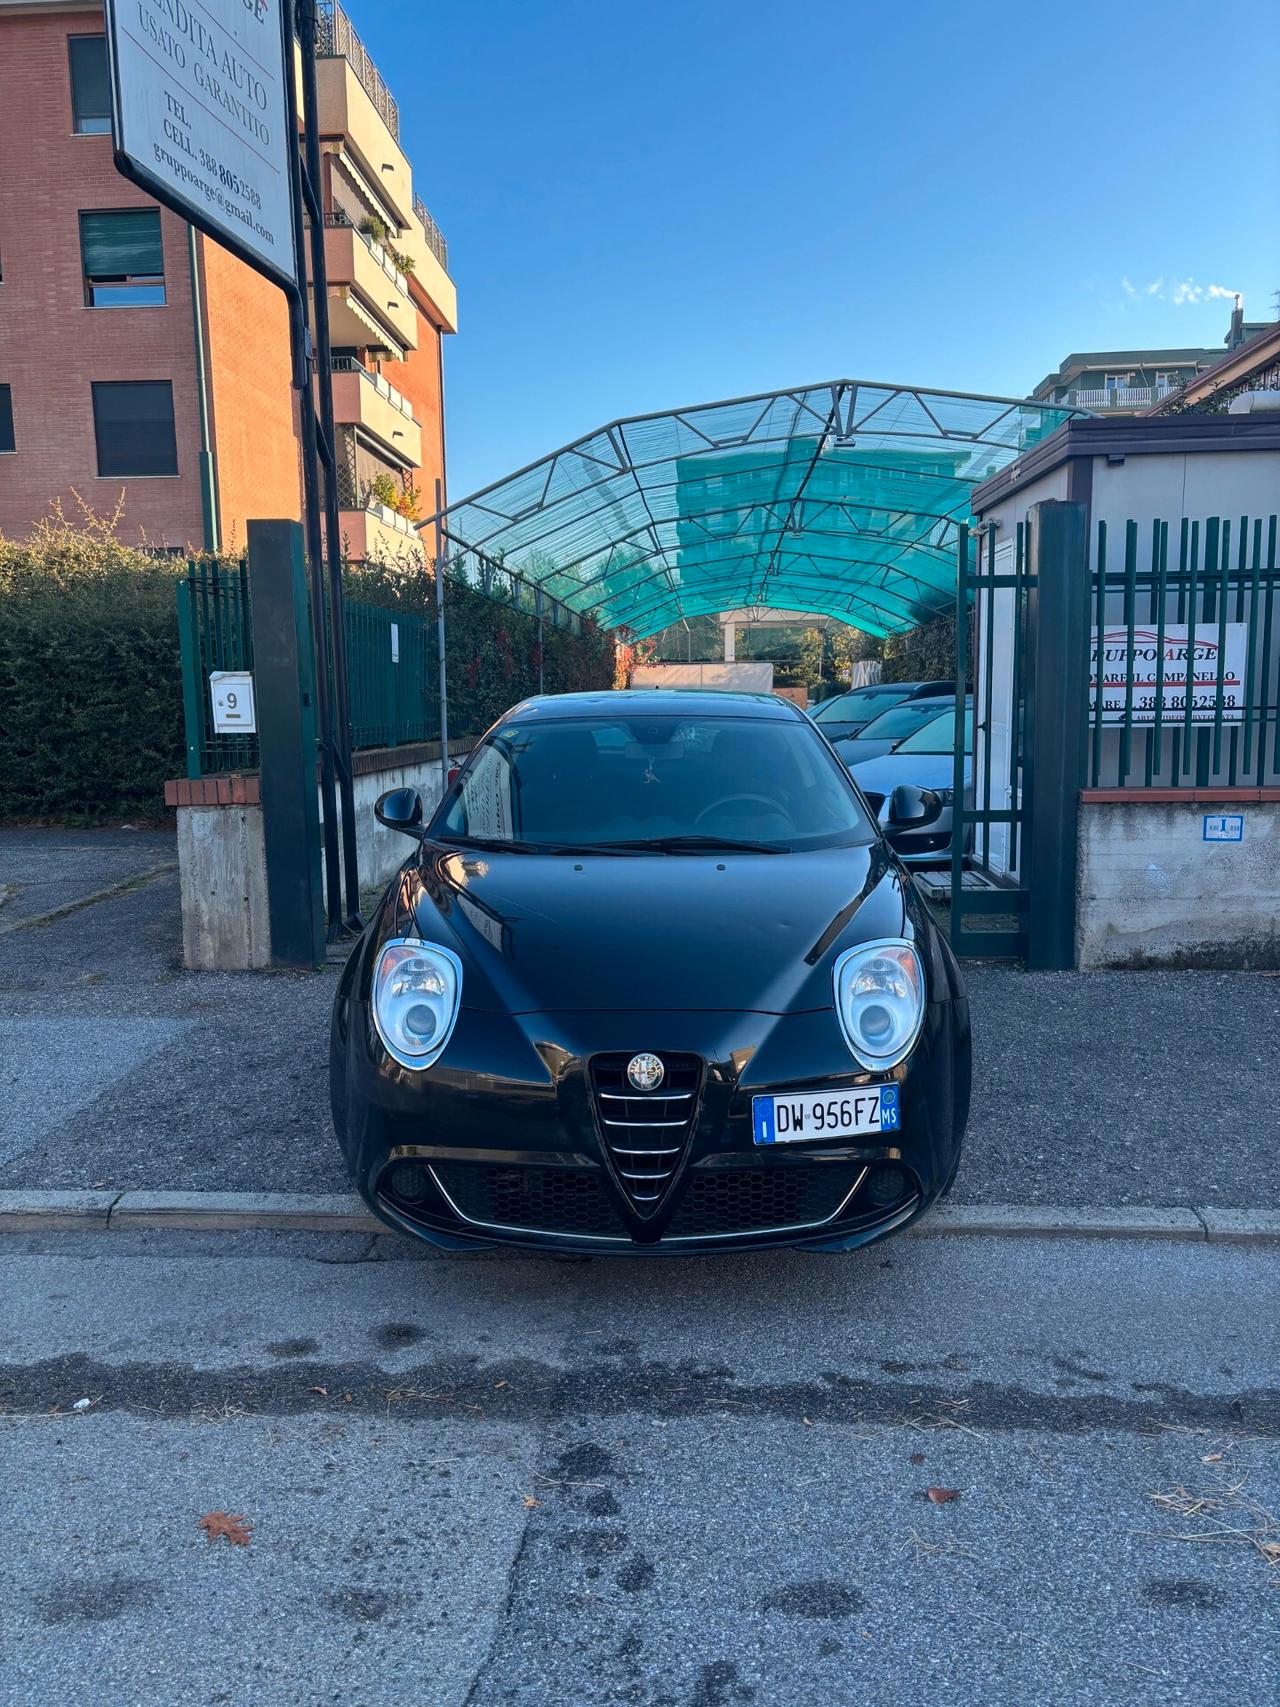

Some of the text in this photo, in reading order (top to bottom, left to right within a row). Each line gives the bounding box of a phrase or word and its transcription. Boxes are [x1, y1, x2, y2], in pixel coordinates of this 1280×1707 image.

[138, 2, 270, 146] USATO GARANTITO
[222, 50, 267, 111] AUTO
[164, 90, 192, 130] TEL.
[164, 118, 198, 161] CELL.
[199, 148, 218, 177] 388
[153, 143, 275, 245] gruppoarge@gmail.com
[1163, 647, 1217, 661] ARGE
[226, 692, 237, 709] 9
[881, 1107, 897, 1125] MS
